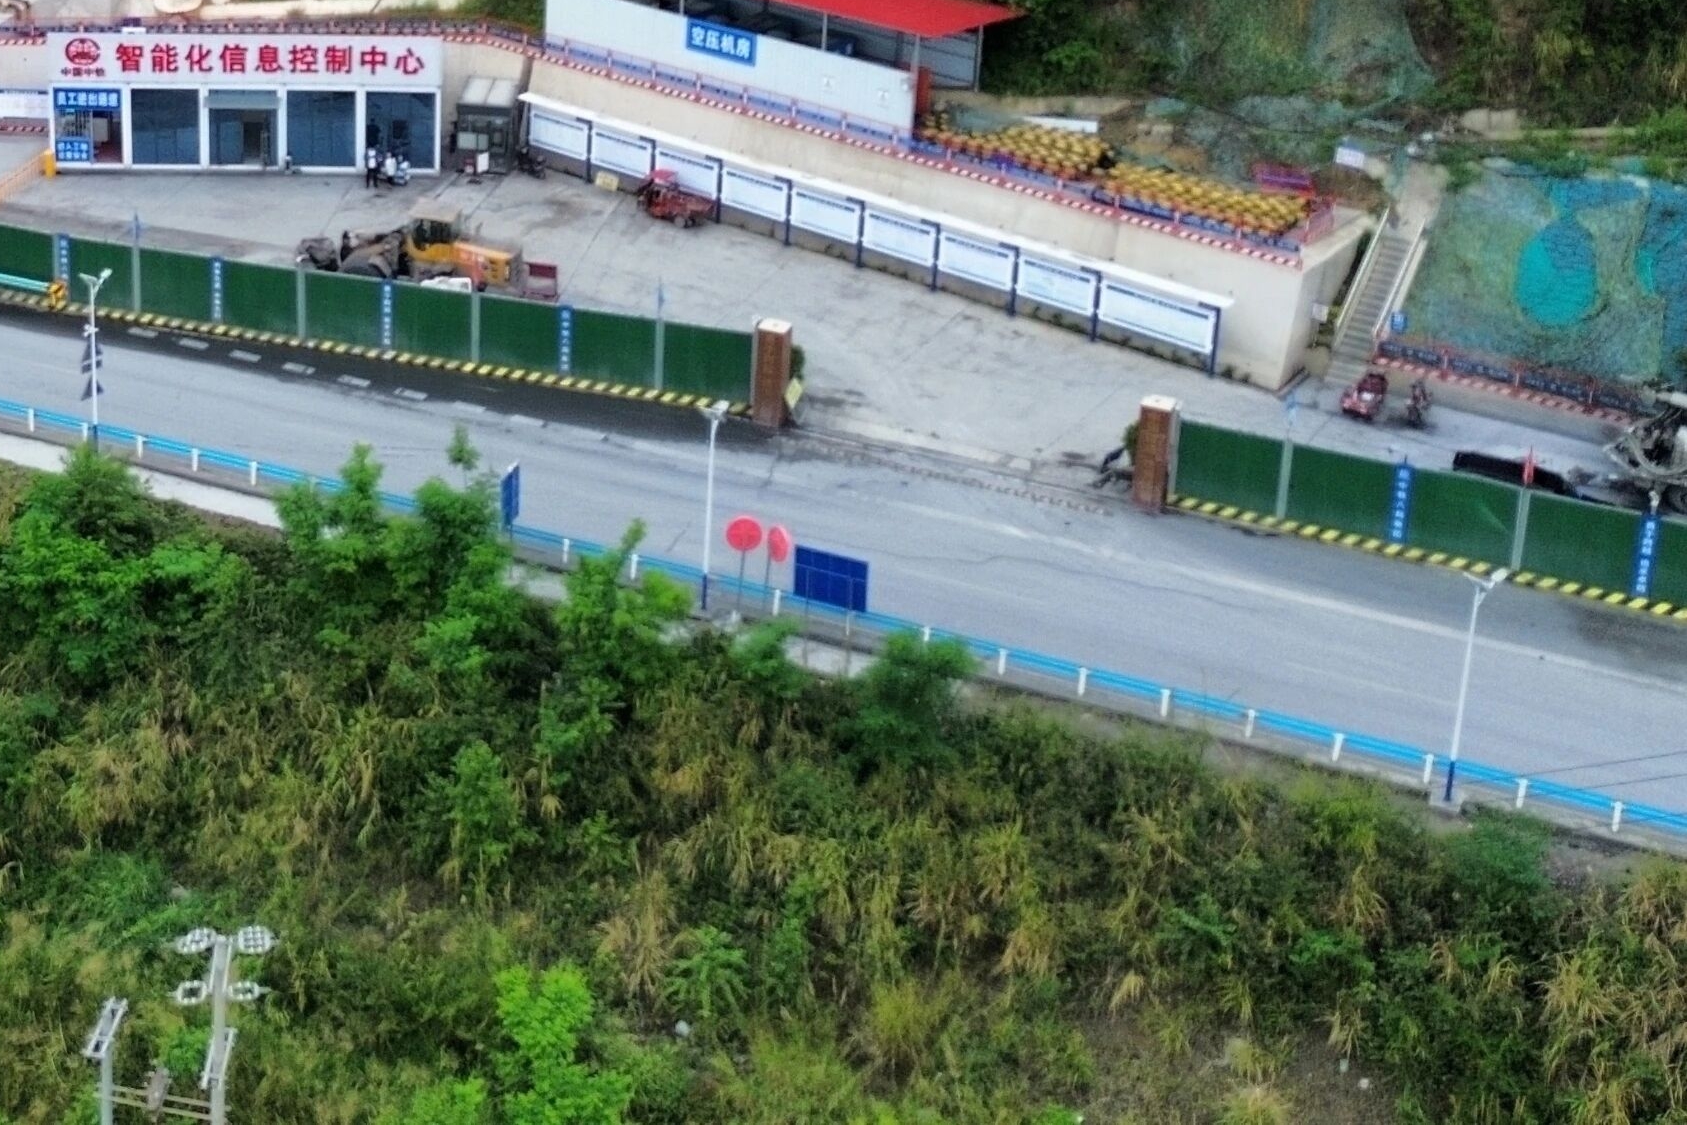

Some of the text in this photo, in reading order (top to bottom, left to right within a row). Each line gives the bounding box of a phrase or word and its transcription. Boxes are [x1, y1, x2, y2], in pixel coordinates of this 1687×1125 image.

[115, 43, 426, 76] 智能化信息控制中心
[691, 25, 752, 60] 空压机房
